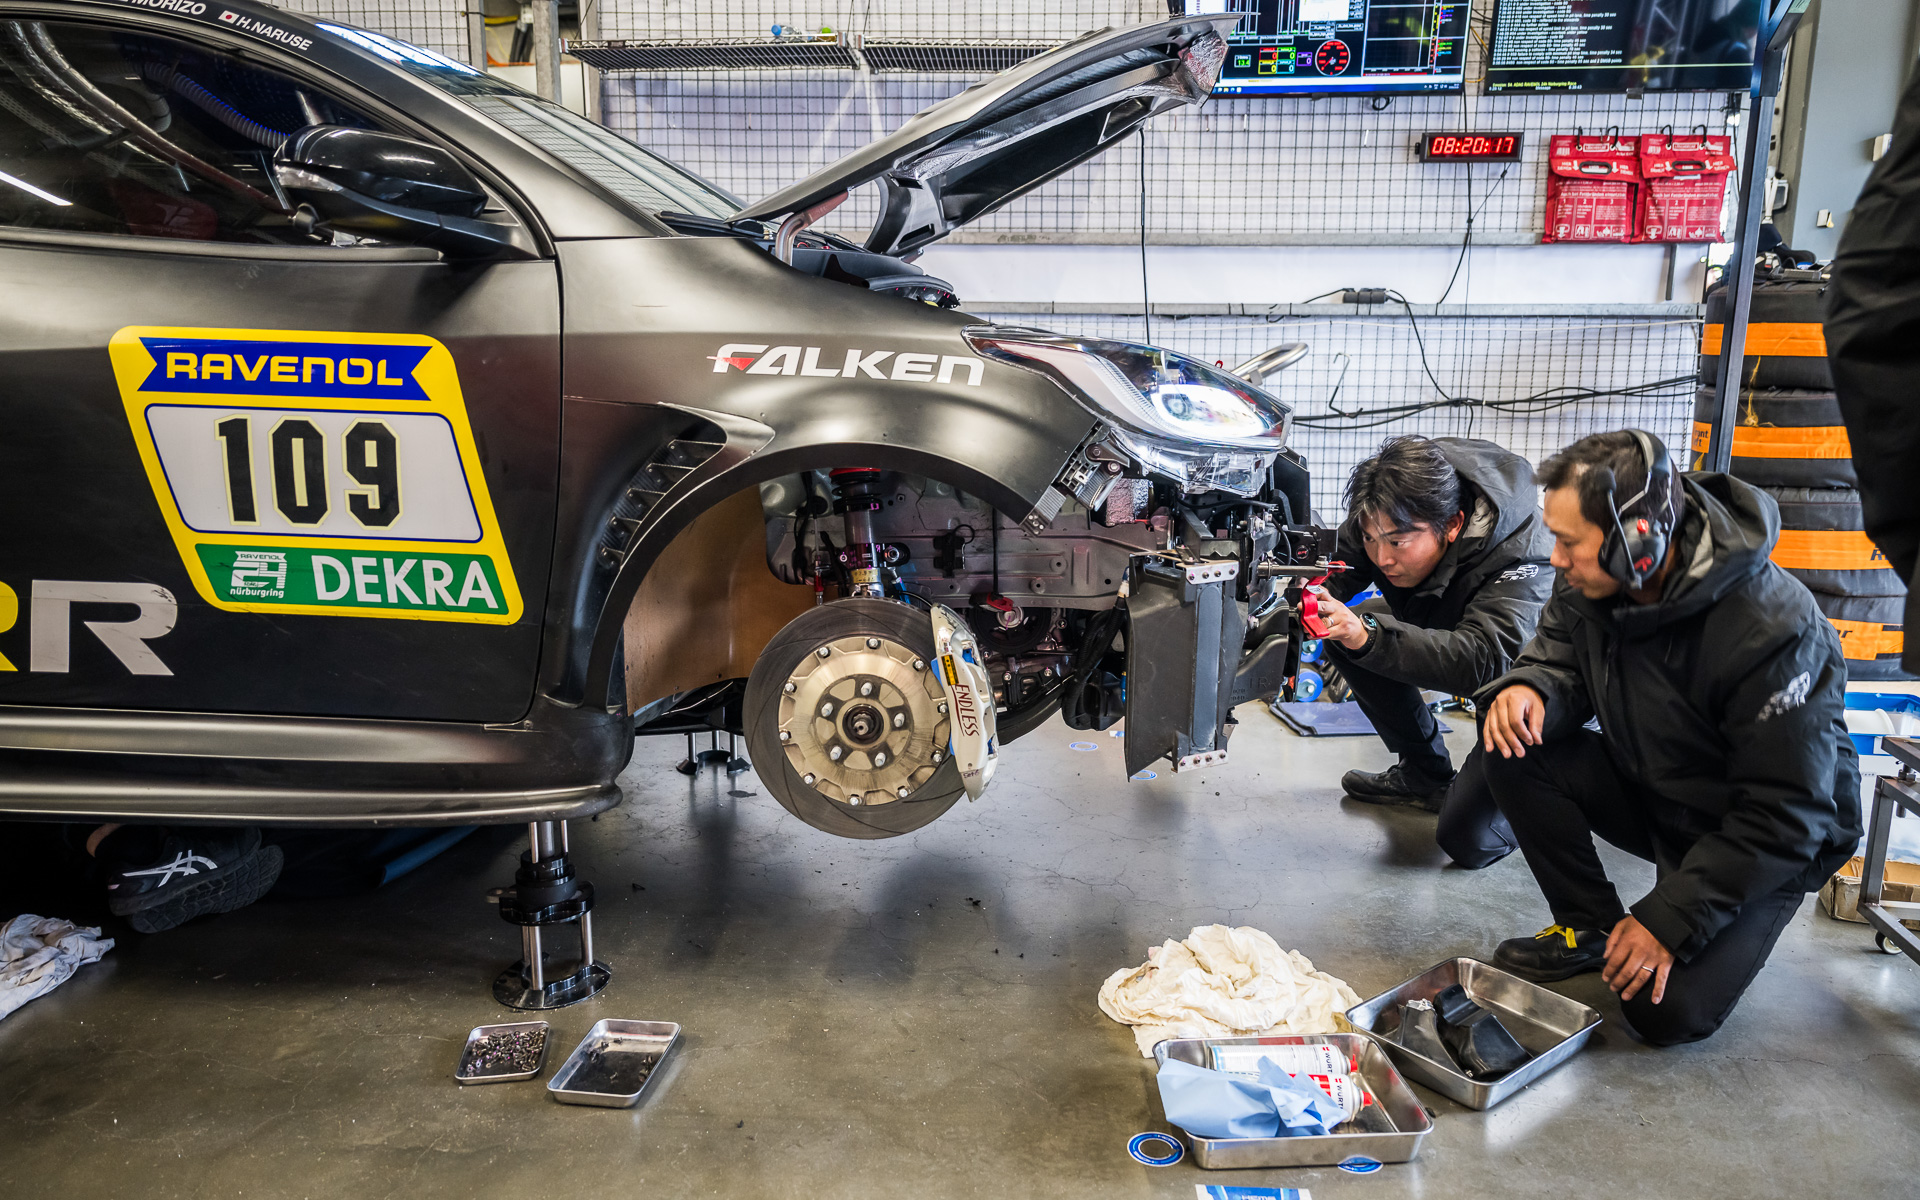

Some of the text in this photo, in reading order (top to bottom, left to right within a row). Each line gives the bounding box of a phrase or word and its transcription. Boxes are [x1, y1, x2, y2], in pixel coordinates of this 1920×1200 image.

[236, 16, 312, 50] H.NARUSE
[1432, 136, 1514, 154] 08:20:17
[166, 352, 403, 386] RAVENOL
[708, 343, 985, 386] FALKEN
[214, 413, 404, 531] 109
[230, 588, 284, 598] nürburgring
[311, 554, 499, 609] DEKRA
[955, 684, 980, 736] ENDLESS
